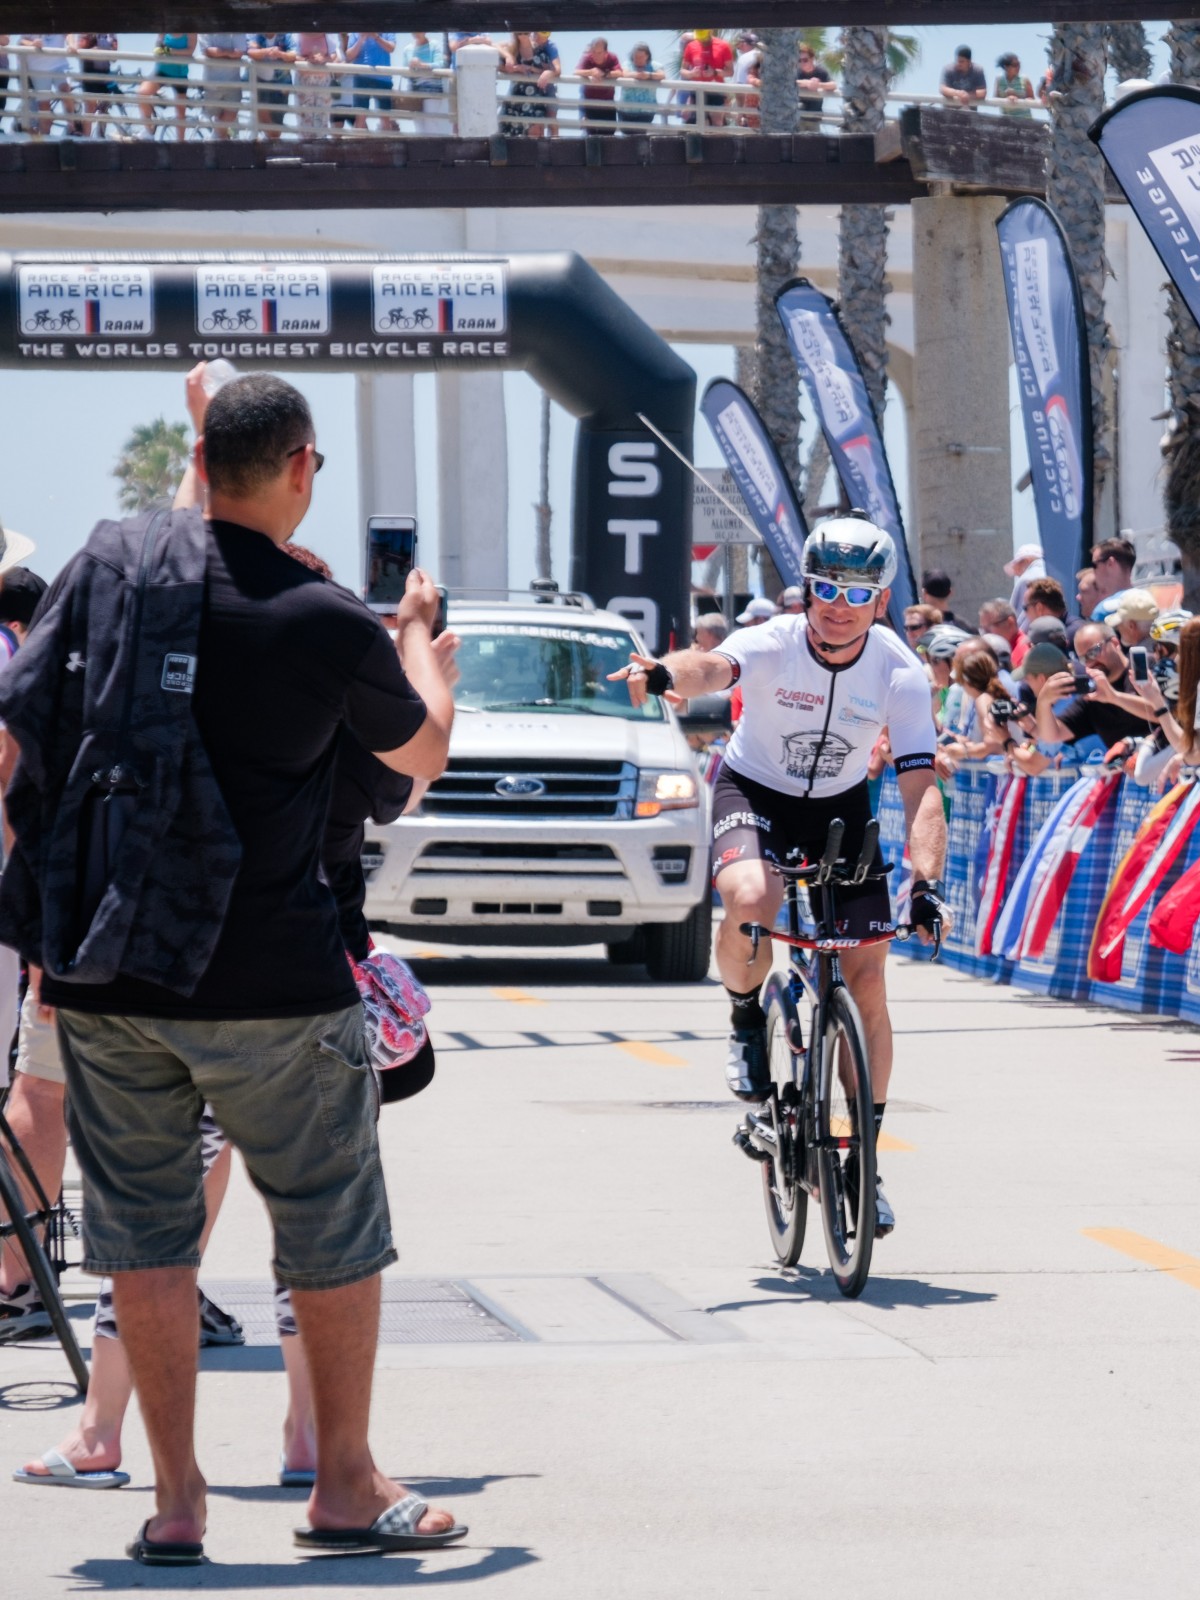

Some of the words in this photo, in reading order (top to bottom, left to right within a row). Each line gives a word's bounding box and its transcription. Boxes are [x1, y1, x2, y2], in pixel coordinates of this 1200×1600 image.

[78, 274, 142, 282] ACROSS
[256, 273, 319, 281] ACROSS
[381, 272, 422, 280] RACE
[431, 272, 495, 280] ACROSS
[28, 284, 143, 298] AMERICA
[206, 284, 320, 296] AMERICA
[382, 283, 496, 296] AMERICA
[104, 320, 144, 331] RAAM
[281, 320, 320, 330] RAAM
[457, 318, 496, 329] RAAM
[18, 343, 64, 356] THE
[76, 344, 178, 357] WORLDS
[189, 343, 320, 357] TOUGHEST
[330, 342, 430, 356] BICYCLE
[442, 342, 508, 354] RACE
[775, 688, 824, 706] FUSION
